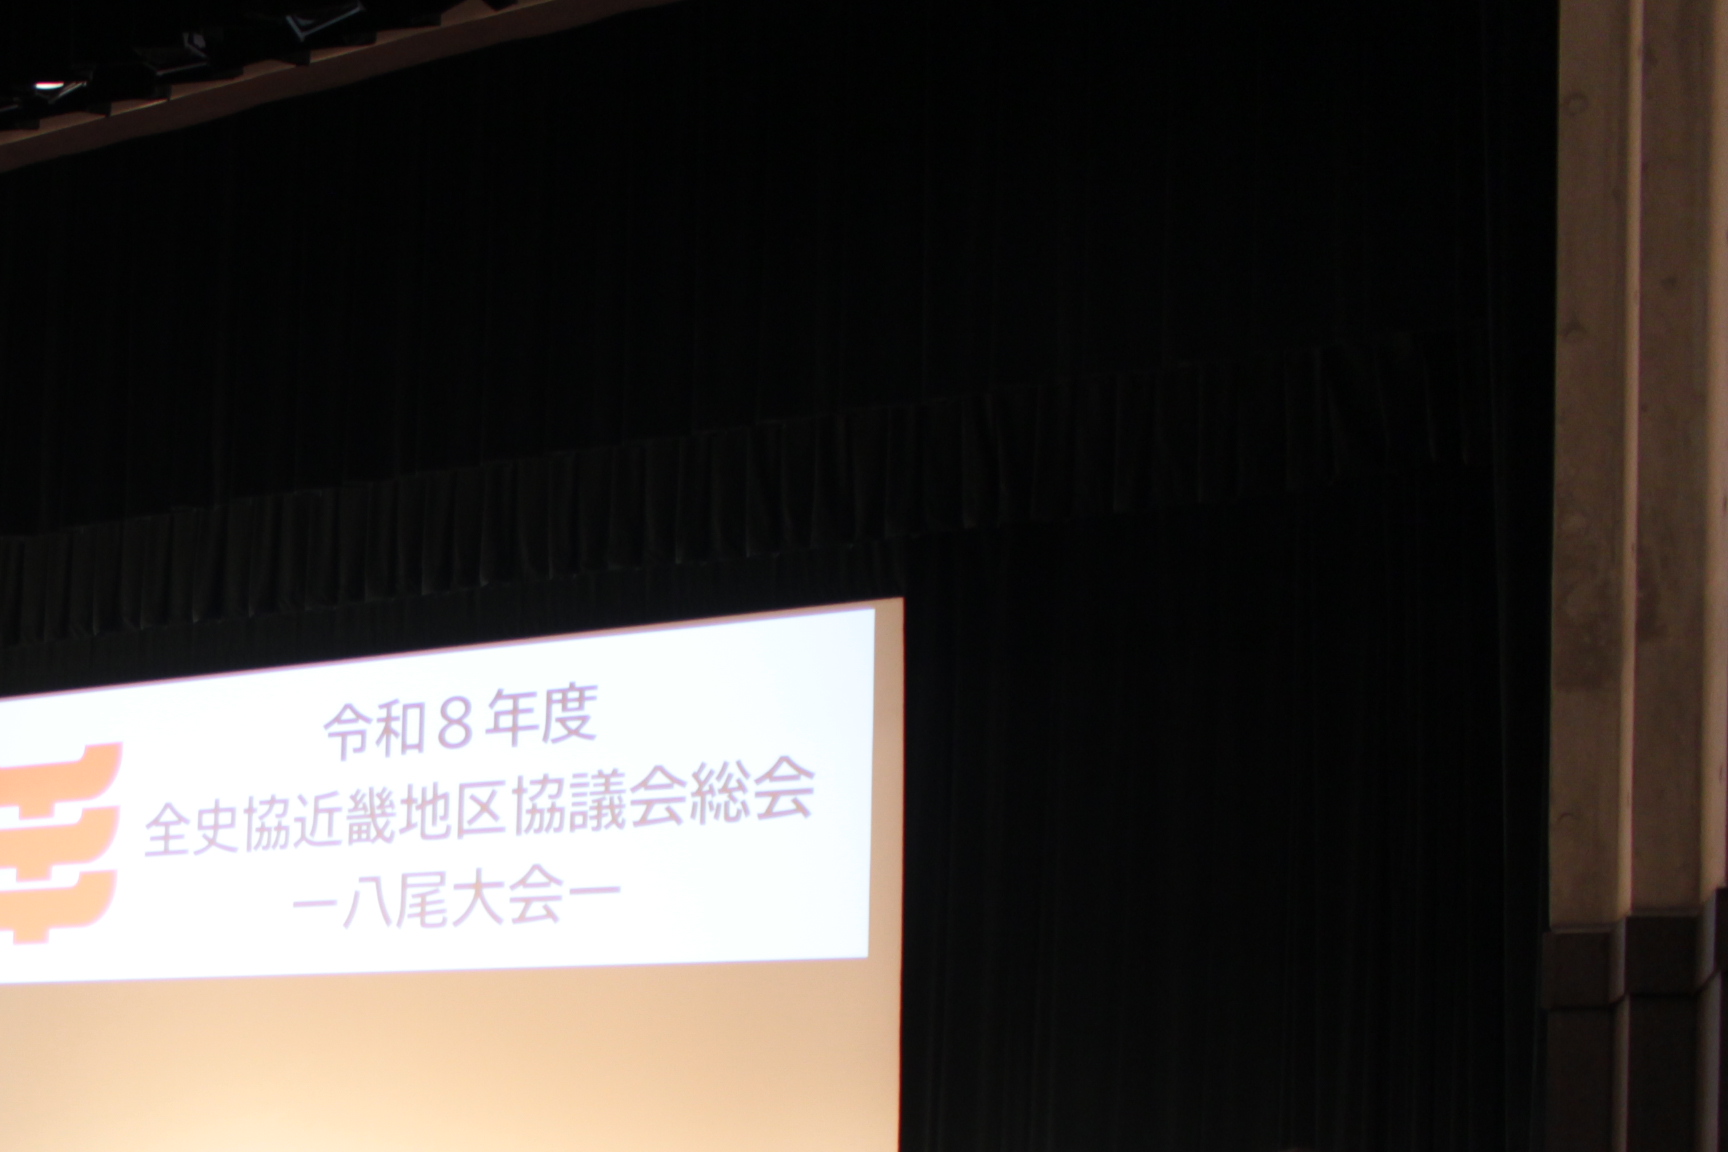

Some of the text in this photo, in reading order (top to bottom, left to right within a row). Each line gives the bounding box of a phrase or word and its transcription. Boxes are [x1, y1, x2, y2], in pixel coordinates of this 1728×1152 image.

[322, 681, 599, 762] 令和8年度
[144, 755, 816, 858] 全史協近畿地区協議会総会
